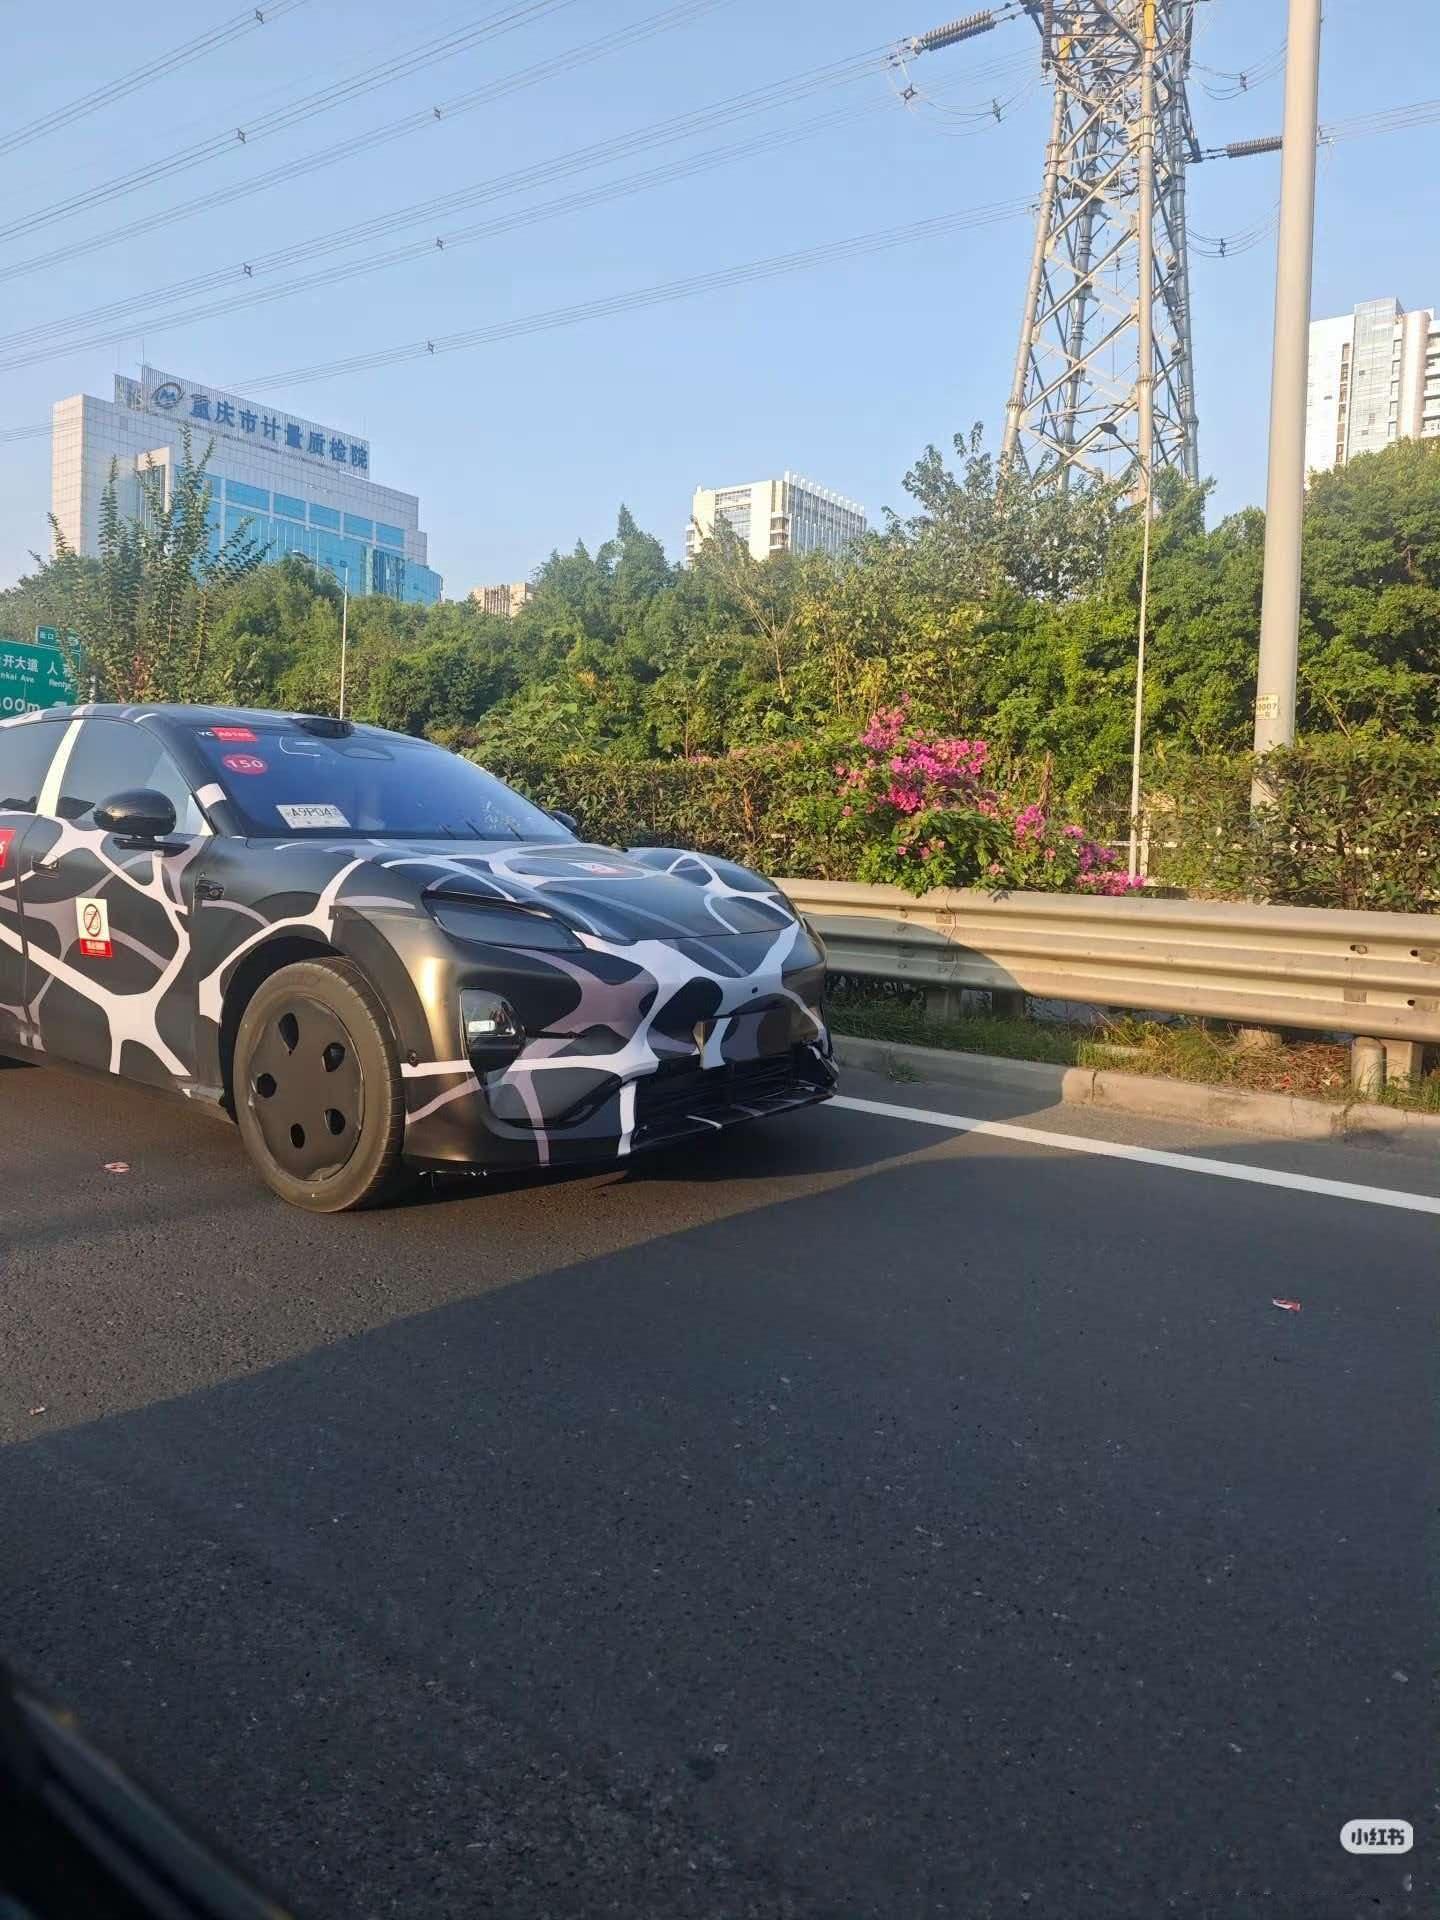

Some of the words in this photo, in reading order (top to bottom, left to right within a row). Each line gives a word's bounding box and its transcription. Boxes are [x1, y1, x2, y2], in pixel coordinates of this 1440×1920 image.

[189, 392, 368, 470] 重庆市计量质检院
[0, 655, 38, 672] 开大道
[0, 696, 41, 713] 00m
[226, 759, 264, 768] 150
